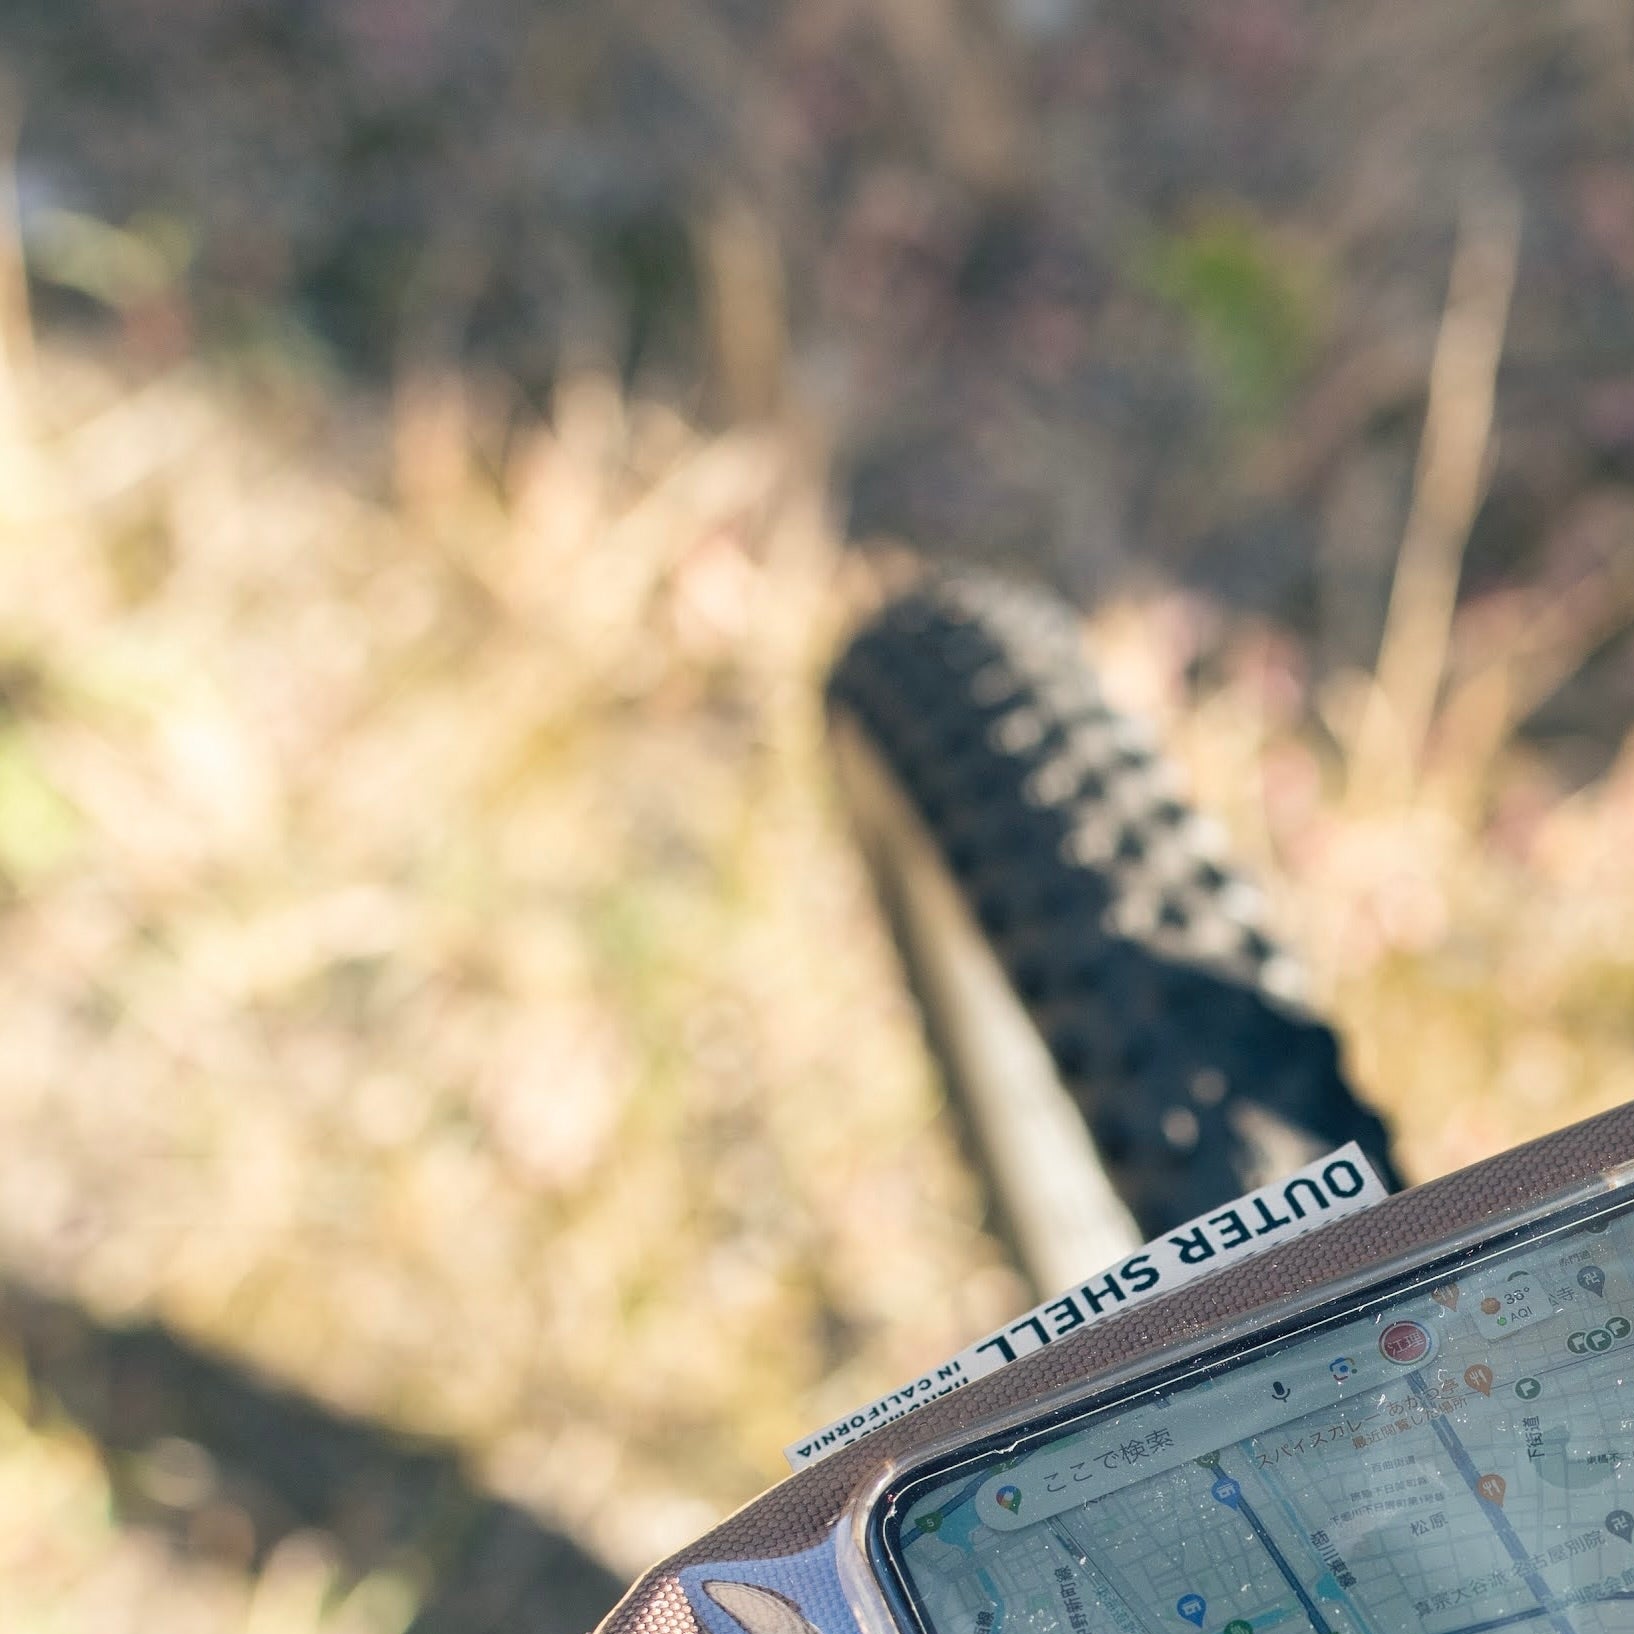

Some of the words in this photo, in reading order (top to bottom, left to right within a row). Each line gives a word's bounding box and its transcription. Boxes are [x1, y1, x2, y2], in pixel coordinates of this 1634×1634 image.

[1169, 1159, 1364, 1265] OUTER
[976, 1255, 1160, 1363] SHELL
[1502, 1285, 1533, 1305] 36°
[1508, 1305, 1533, 1322] AQI
[1386, 1330, 1425, 1356] 江理
[937, 1360, 962, 1382] IN
[797, 1378, 932, 1457] CALIFORNIA
[1254, 1408, 1383, 1470] スパイスカレー
[1351, 1394, 1469, 1451] 最近閲覧した場所
[1521, 1414, 1547, 1460] 下街道
[1040, 1425, 1176, 1496] ここで検索
[1408, 1510, 1449, 1538] 松原
[1509, 1528, 1606, 1580] 名古屋別院
